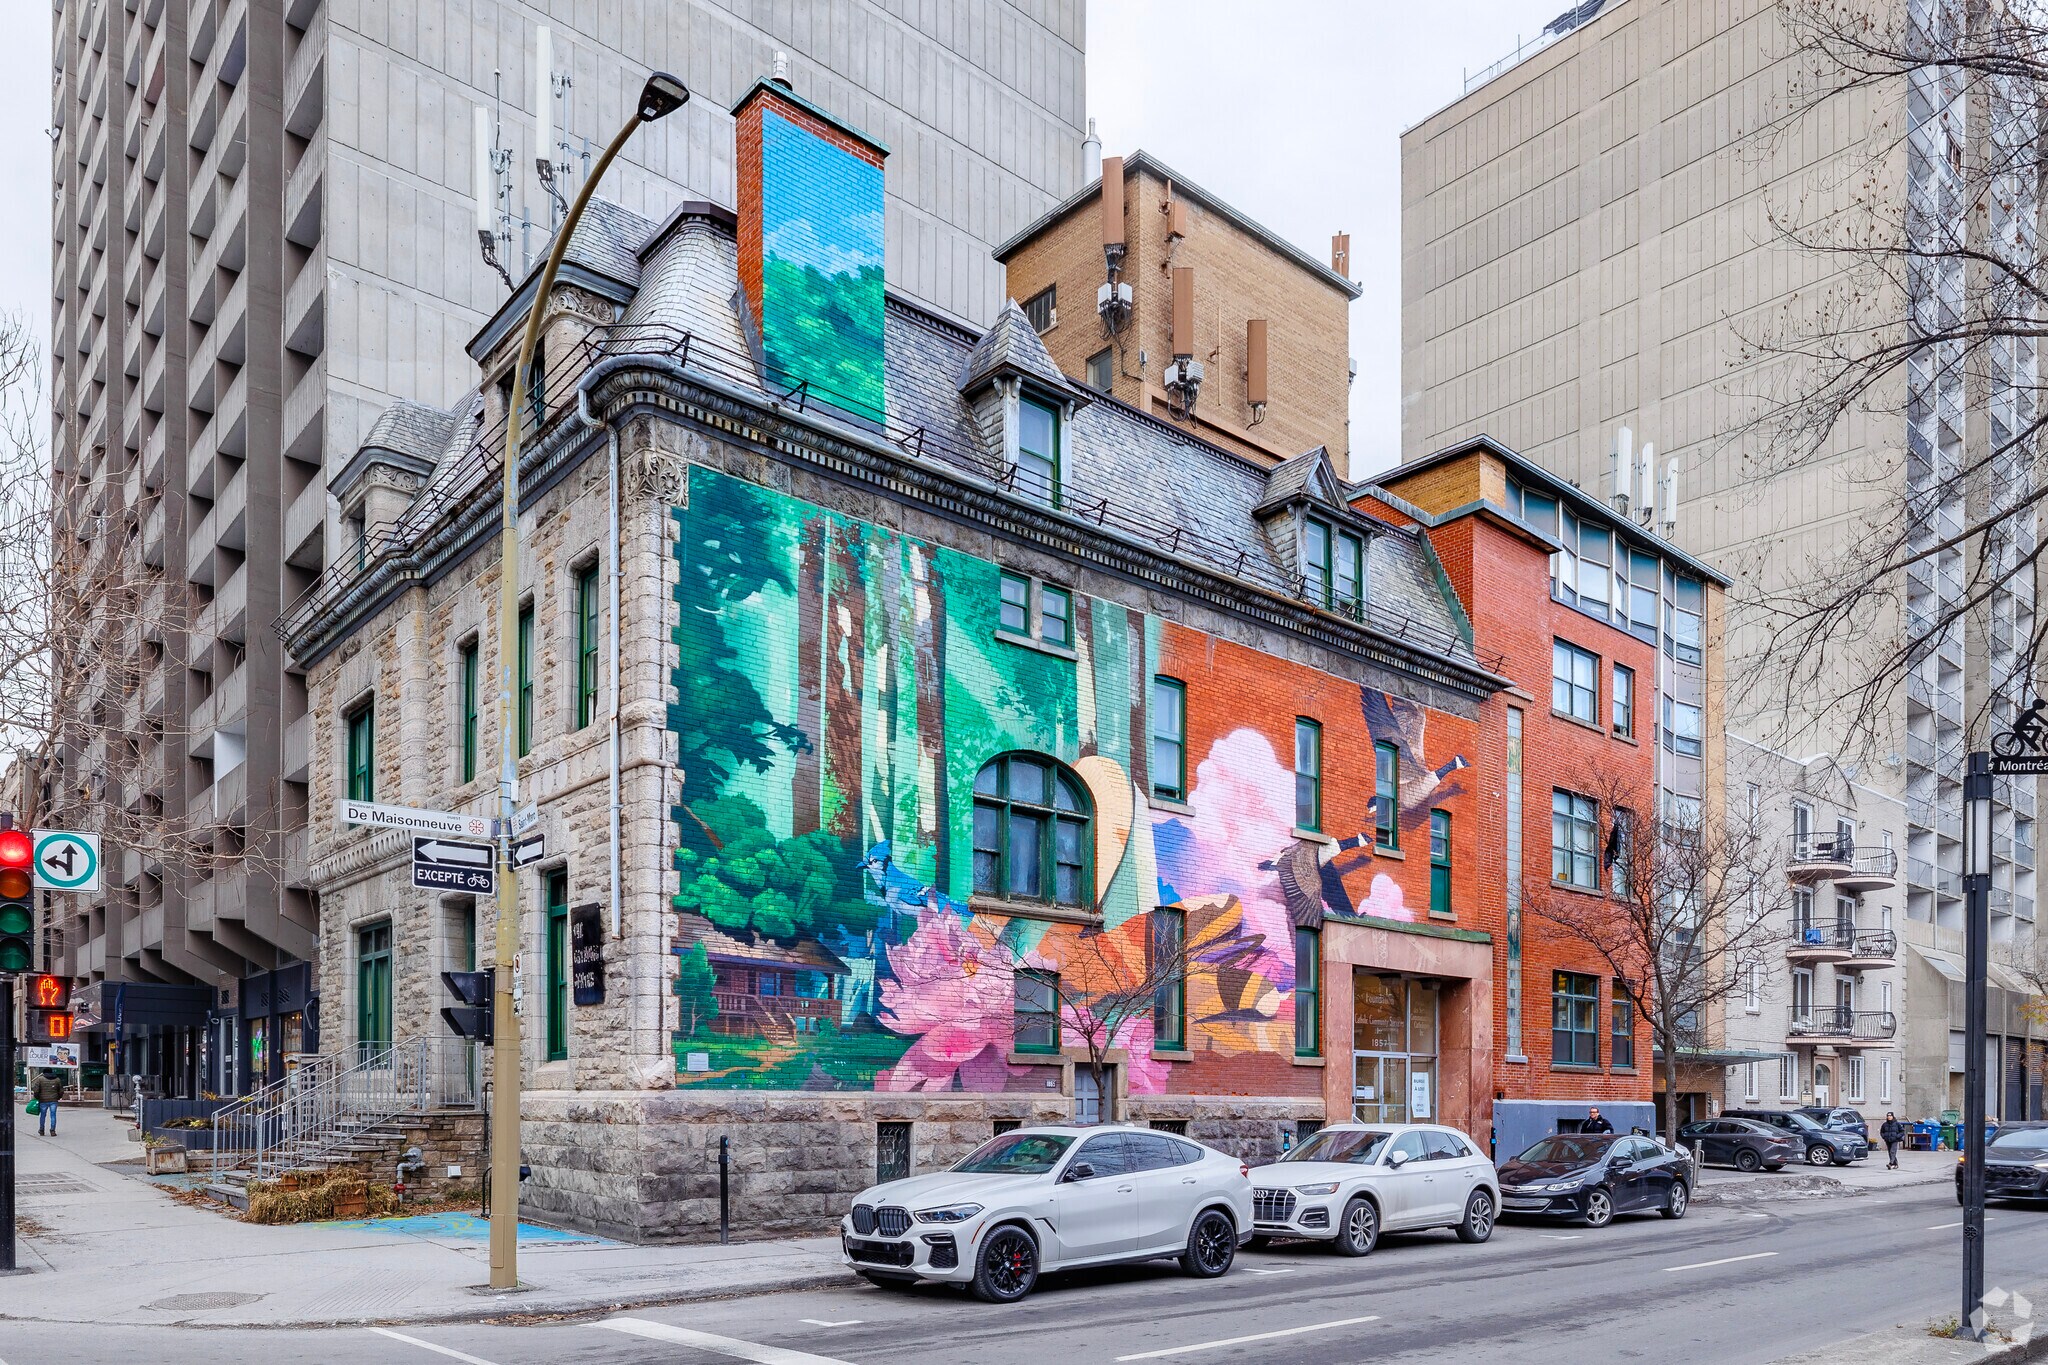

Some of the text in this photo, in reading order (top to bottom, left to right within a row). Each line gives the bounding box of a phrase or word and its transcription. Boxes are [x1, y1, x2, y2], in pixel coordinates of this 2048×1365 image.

[348, 802, 375, 810] Boulevard
[348, 807, 462, 832] De Maisonneuve
[417, 868, 465, 885] EXCEPTÉ
